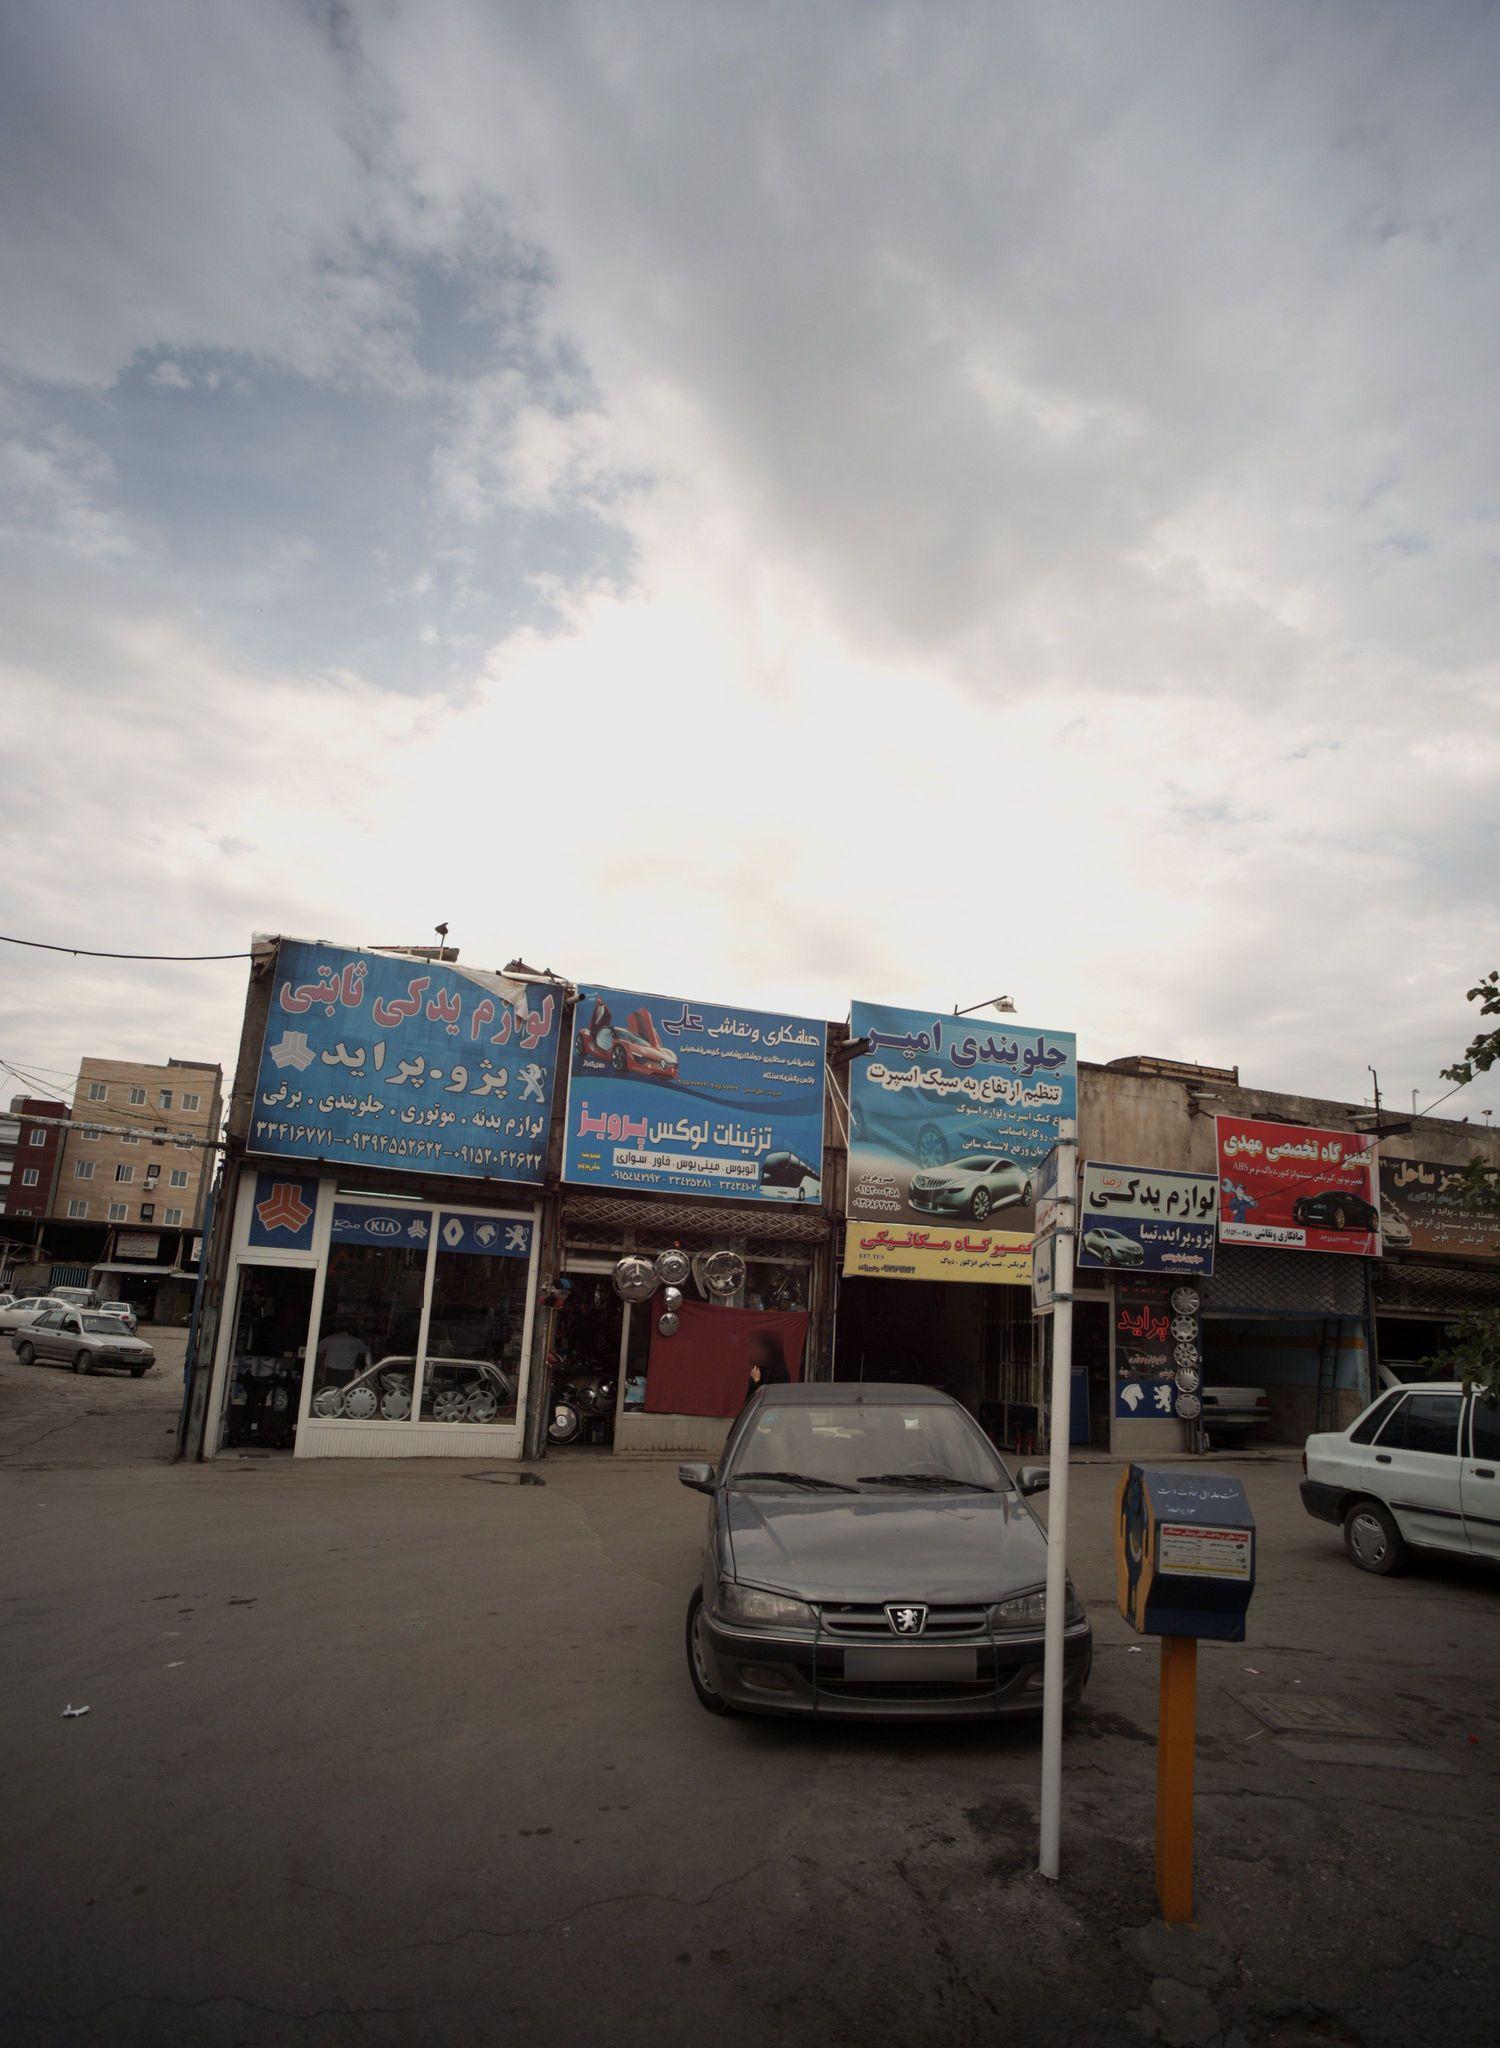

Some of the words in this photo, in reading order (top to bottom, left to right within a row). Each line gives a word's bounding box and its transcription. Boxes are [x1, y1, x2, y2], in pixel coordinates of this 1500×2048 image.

[280, 961, 368, 1017] ثابتی
[373, 976, 461, 1036] یدکی
[662, 1004, 704, 1036] علی
[762, 1024, 820, 1048] صافکاری
[865, 1020, 942, 1060] امیر
[951, 1036, 1068, 1080] جلوبندی
[869, 1066, 918, 1088] اسپرت
[922, 1071, 958, 1093] سبک
[962, 1079, 977, 1093] به
[262, 1081, 303, 1109] برقی
[983, 1082, 1021, 1101] ارتفاع
[1023, 1085, 1060, 1102] تنظیم
[318, 1093, 385, 1119] جلوبندی
[400, 1103, 456, 1128] موتوری
[472, 1108, 502, 1134] بدنه
[505, 1115, 544, 1139] لوازم
[577, 1101, 648, 1151] پرویز
[649, 1118, 709, 1150] لوکس
[713, 1121, 773, 1157] تزئینات
[1223, 1134, 1263, 1157] مهدی
[616, 1151, 647, 1166] سواری
[652, 1154, 671, 1168] خاور
[1265, 1138, 1319, 1162] تخصصی
[725, 1163, 756, 1178] اتوبوس
[1101, 1175, 1123, 1188] رضا
[1393, 1161, 1435, 1187] ساحل
[1089, 1179, 1160, 1213] یدکی
[1166, 1184, 1215, 1218] لوازم
[370, 1220, 395, 1233] KIA
[860, 1229, 951, 1251] مکانیکی
[1118, 1304, 1169, 1343] پراید
